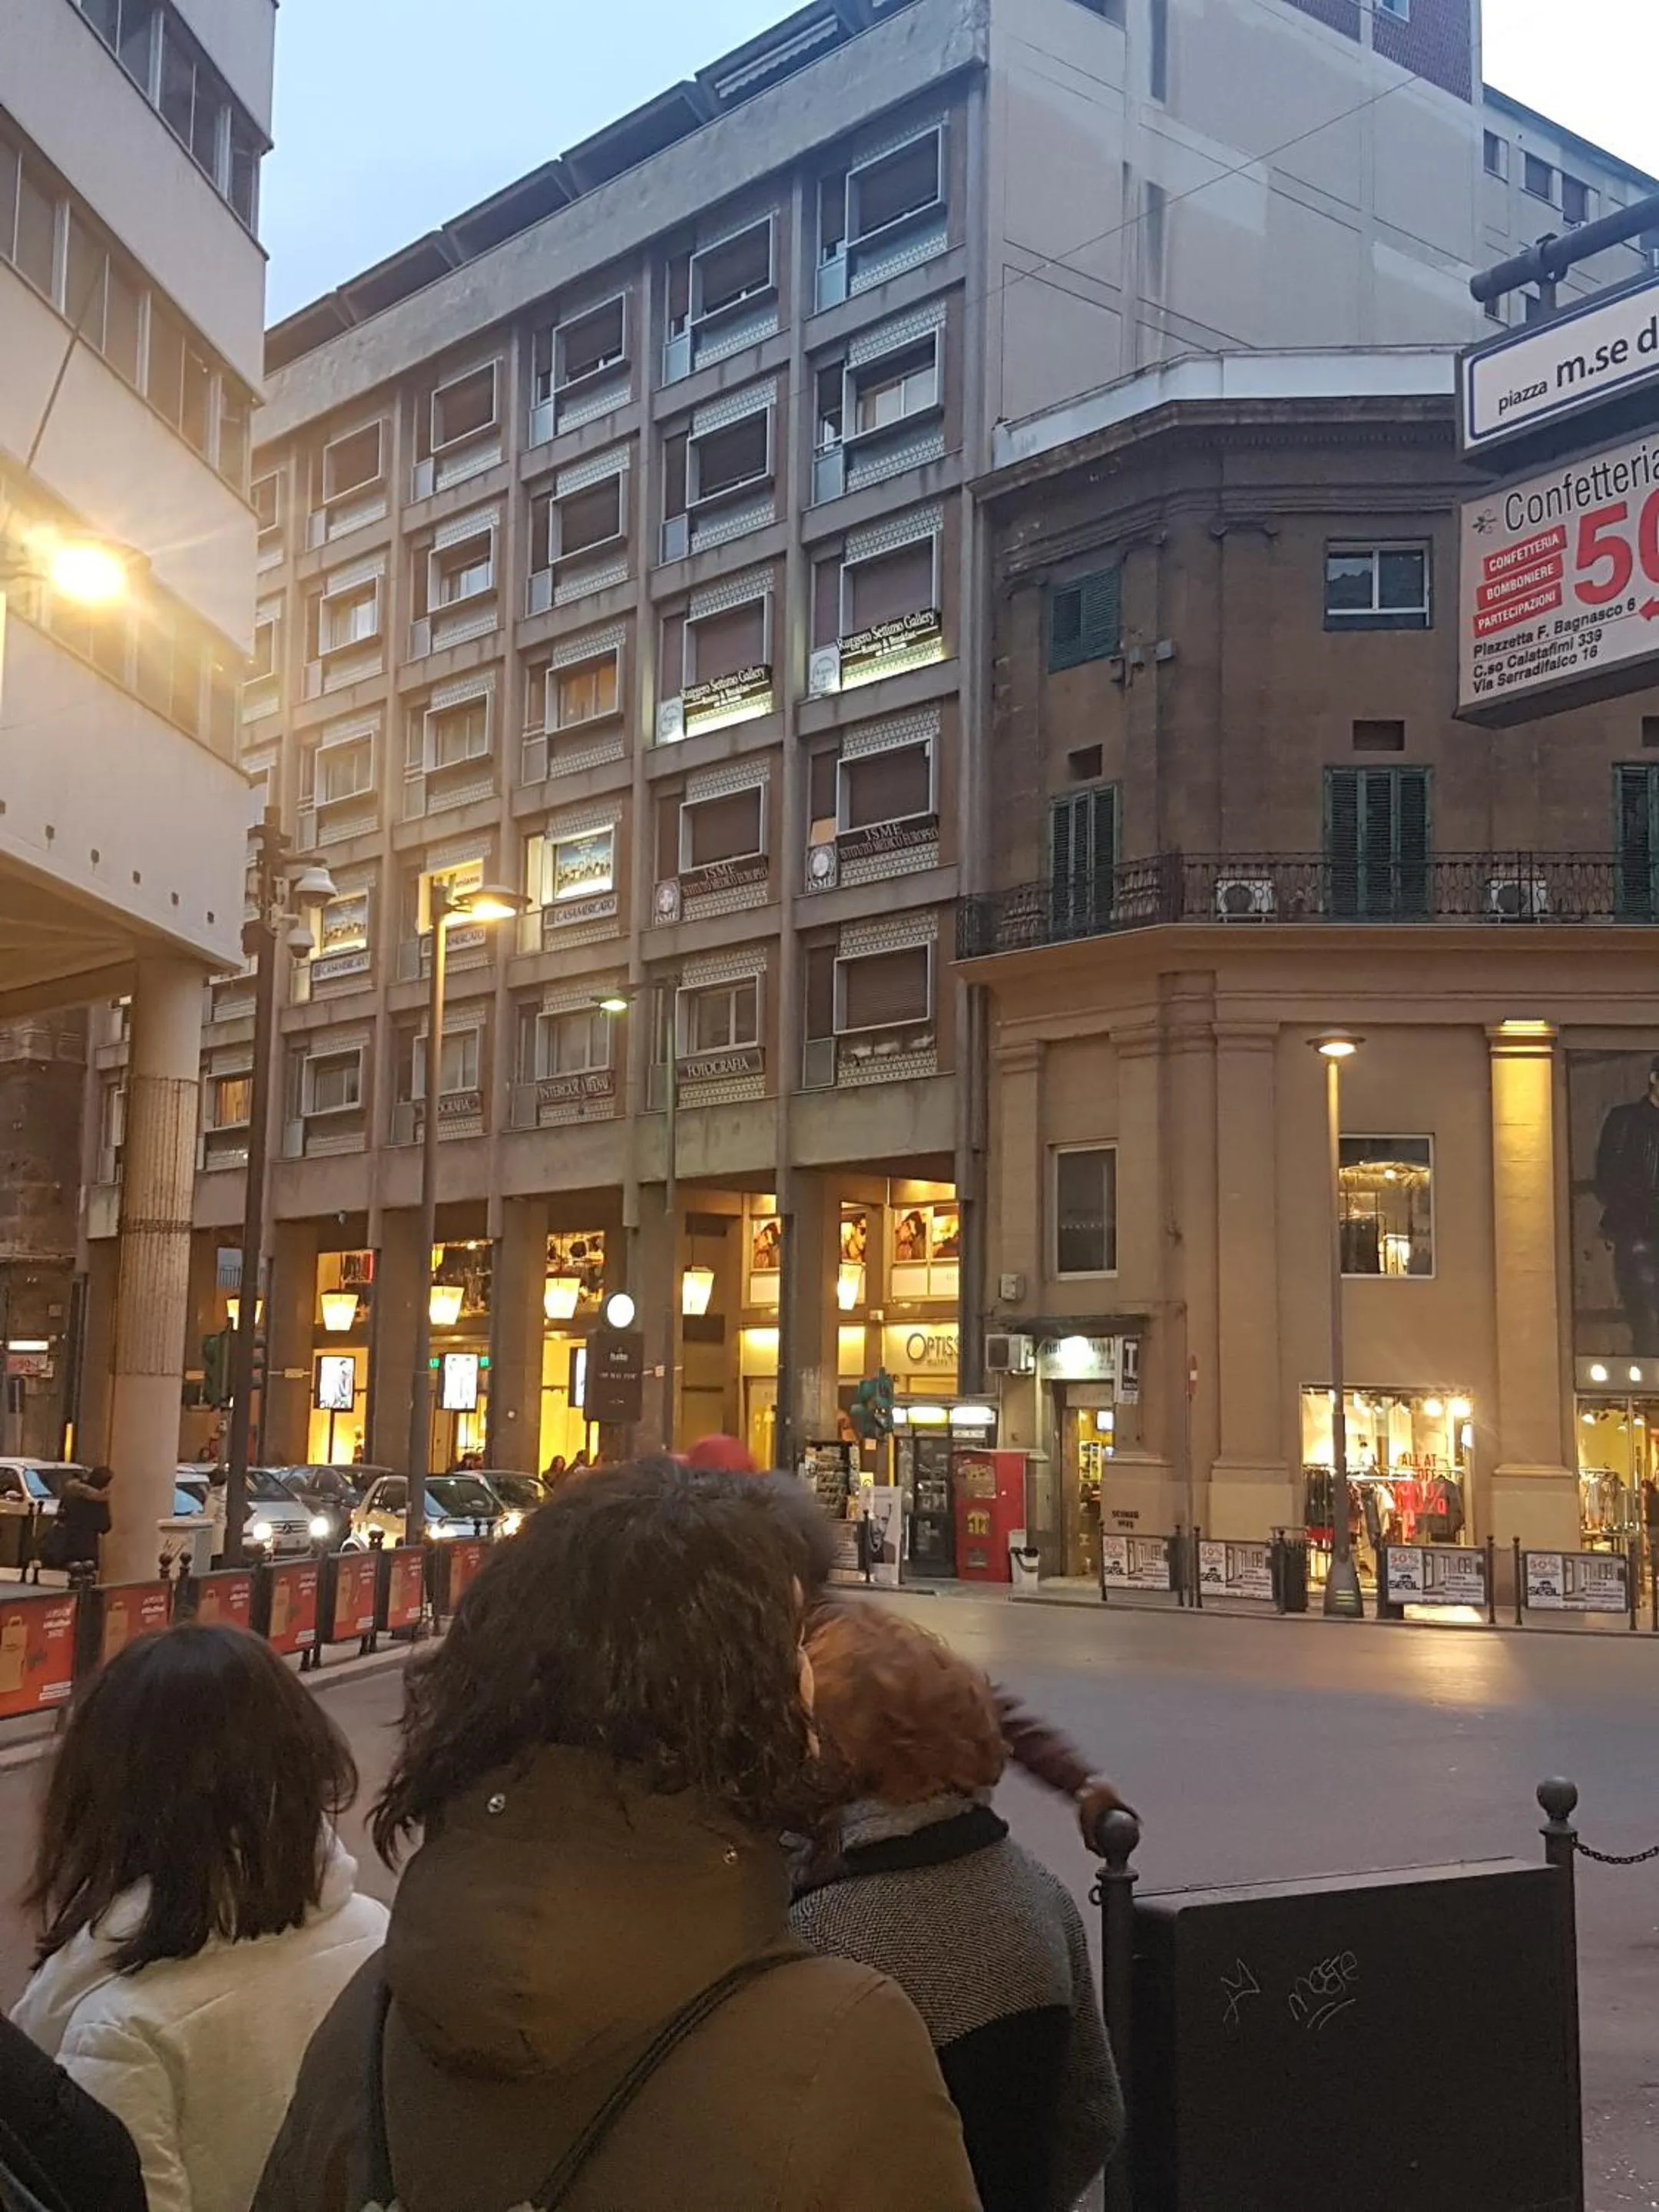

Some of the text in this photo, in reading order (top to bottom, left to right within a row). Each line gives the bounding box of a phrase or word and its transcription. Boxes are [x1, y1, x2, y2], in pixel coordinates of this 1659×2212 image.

[1499, 380, 1548, 416] piazza
[1556, 338, 1628, 387] m.se
[1488, 533, 1559, 572] CONFETTERIA
[1486, 562, 1555, 600] BOMBONIERE
[903, 612, 935, 629] Gallery
[1478, 591, 1556, 630] PARTECIPAZIONI
[1473, 631, 1533, 658] Piazzetta
[1537, 624, 1549, 640] F.
[1554, 604, 1623, 634] Bagnasco
[1472, 628, 1603, 680] C.so Calatafimi 339
[1472, 677, 1493, 694] Via
[1497, 654, 1578, 687] Serradifalco
[865, 823, 903, 841] ISME
[687, 1057, 749, 1077] FOTOGRAFIA
